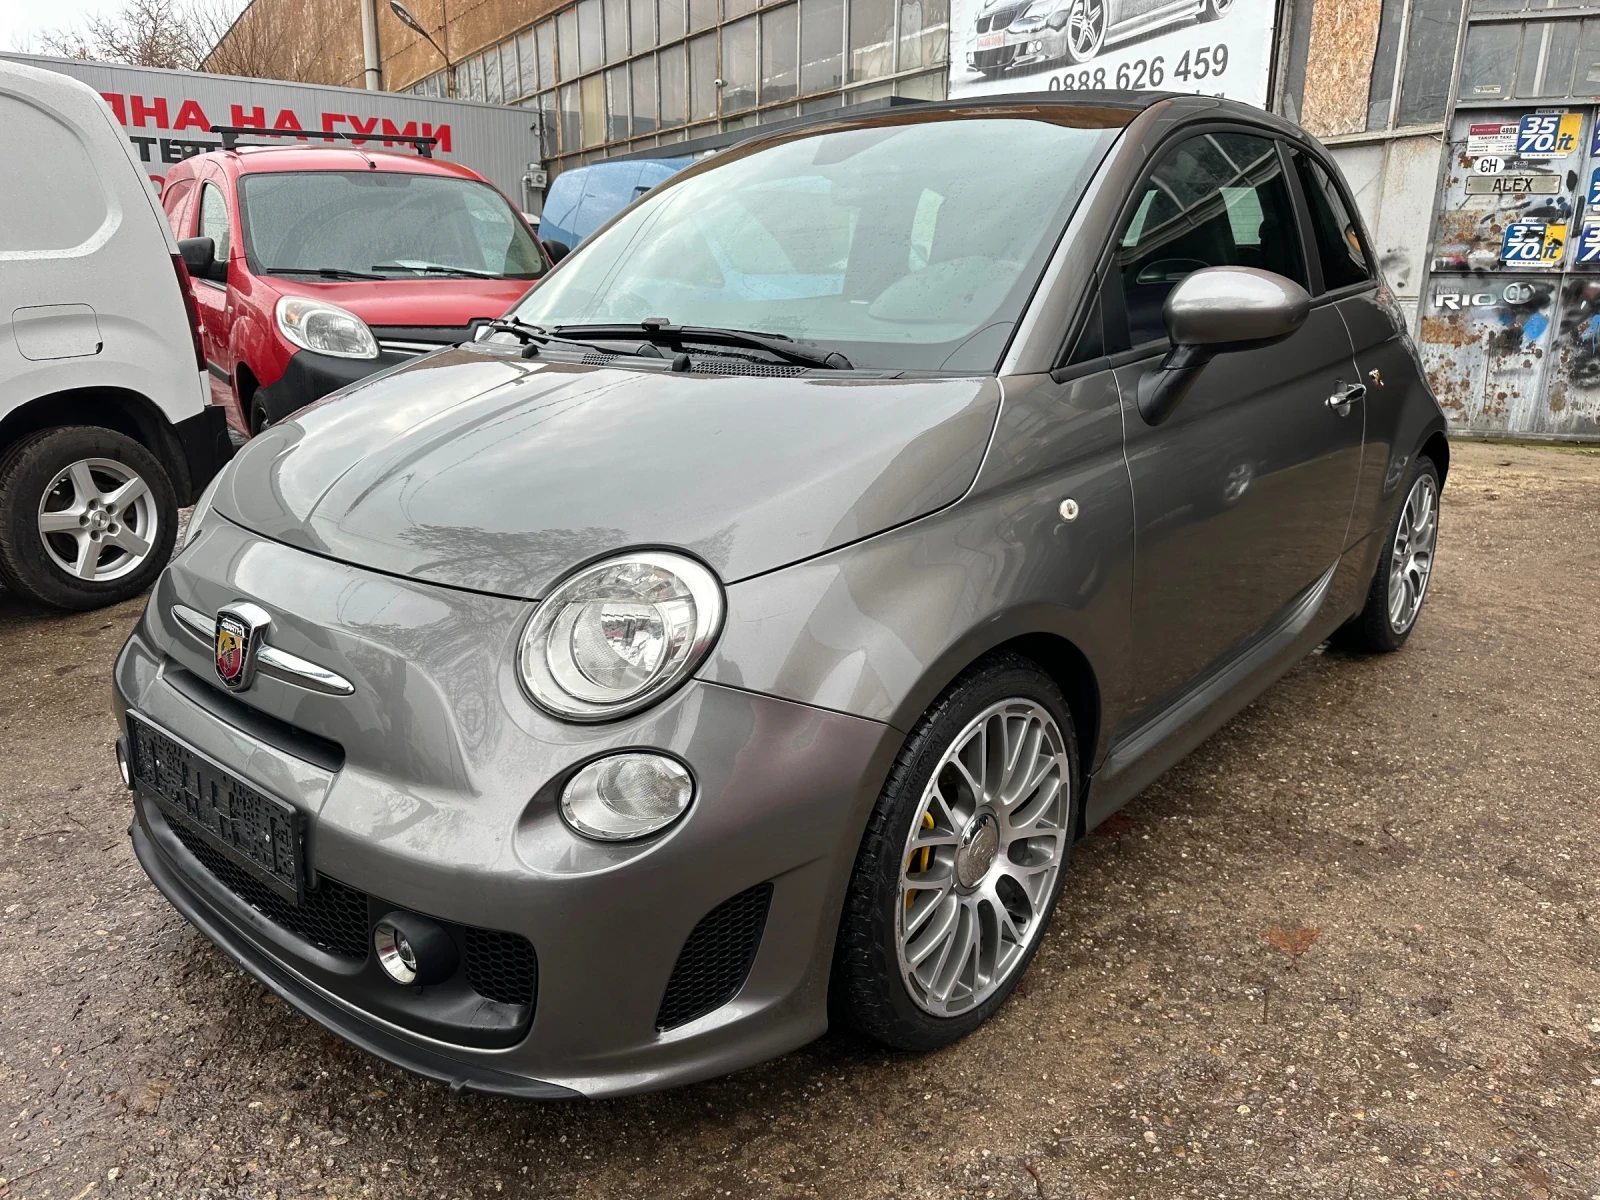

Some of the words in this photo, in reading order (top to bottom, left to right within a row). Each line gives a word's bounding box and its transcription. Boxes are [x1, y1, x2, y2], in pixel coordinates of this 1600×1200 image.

[1116, 55, 1165, 90] 626
[1174, 43, 1229, 82] 459
[230, 104, 308, 141] НА
[321, 112, 452, 152] ГУМИ
[1521, 116, 1559, 134] 35
[1480, 158, 1498, 173] CH
[1492, 177, 1534, 192] ALEX
[1436, 285, 1460, 294] New
[1435, 293, 1498, 310] RIO
[221, 620, 244, 637] ABARTH
